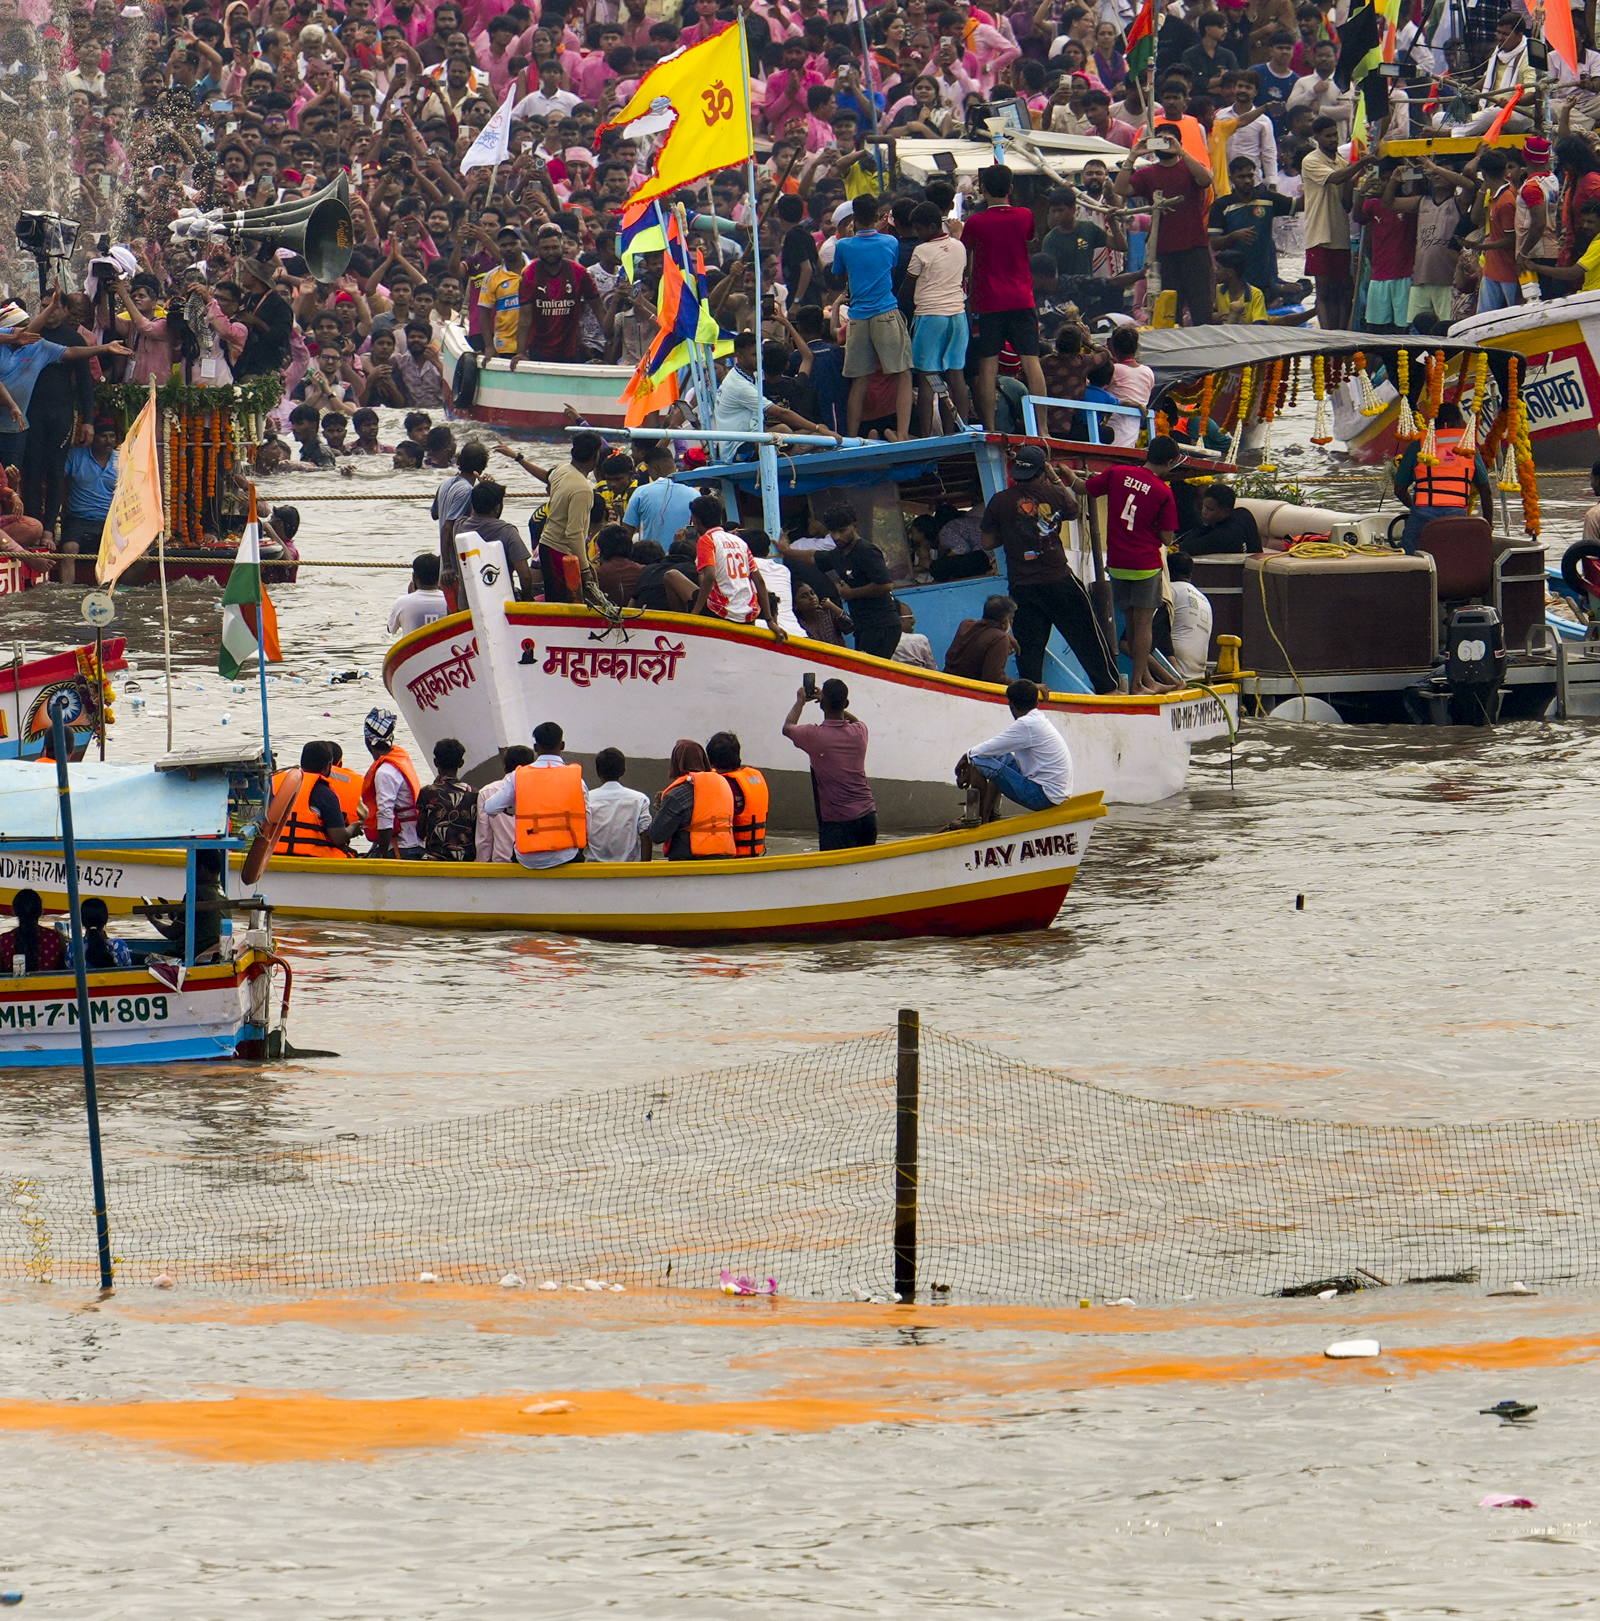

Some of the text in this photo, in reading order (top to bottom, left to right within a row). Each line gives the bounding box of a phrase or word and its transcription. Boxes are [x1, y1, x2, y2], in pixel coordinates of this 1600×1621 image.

[1120, 493, 1138, 531] 4
[726, 552, 749, 580] 02
[405, 644, 477, 713] महाकाली
[542, 634, 687, 688] महाकाली
[964, 832, 1079, 872] JAY AMBE
